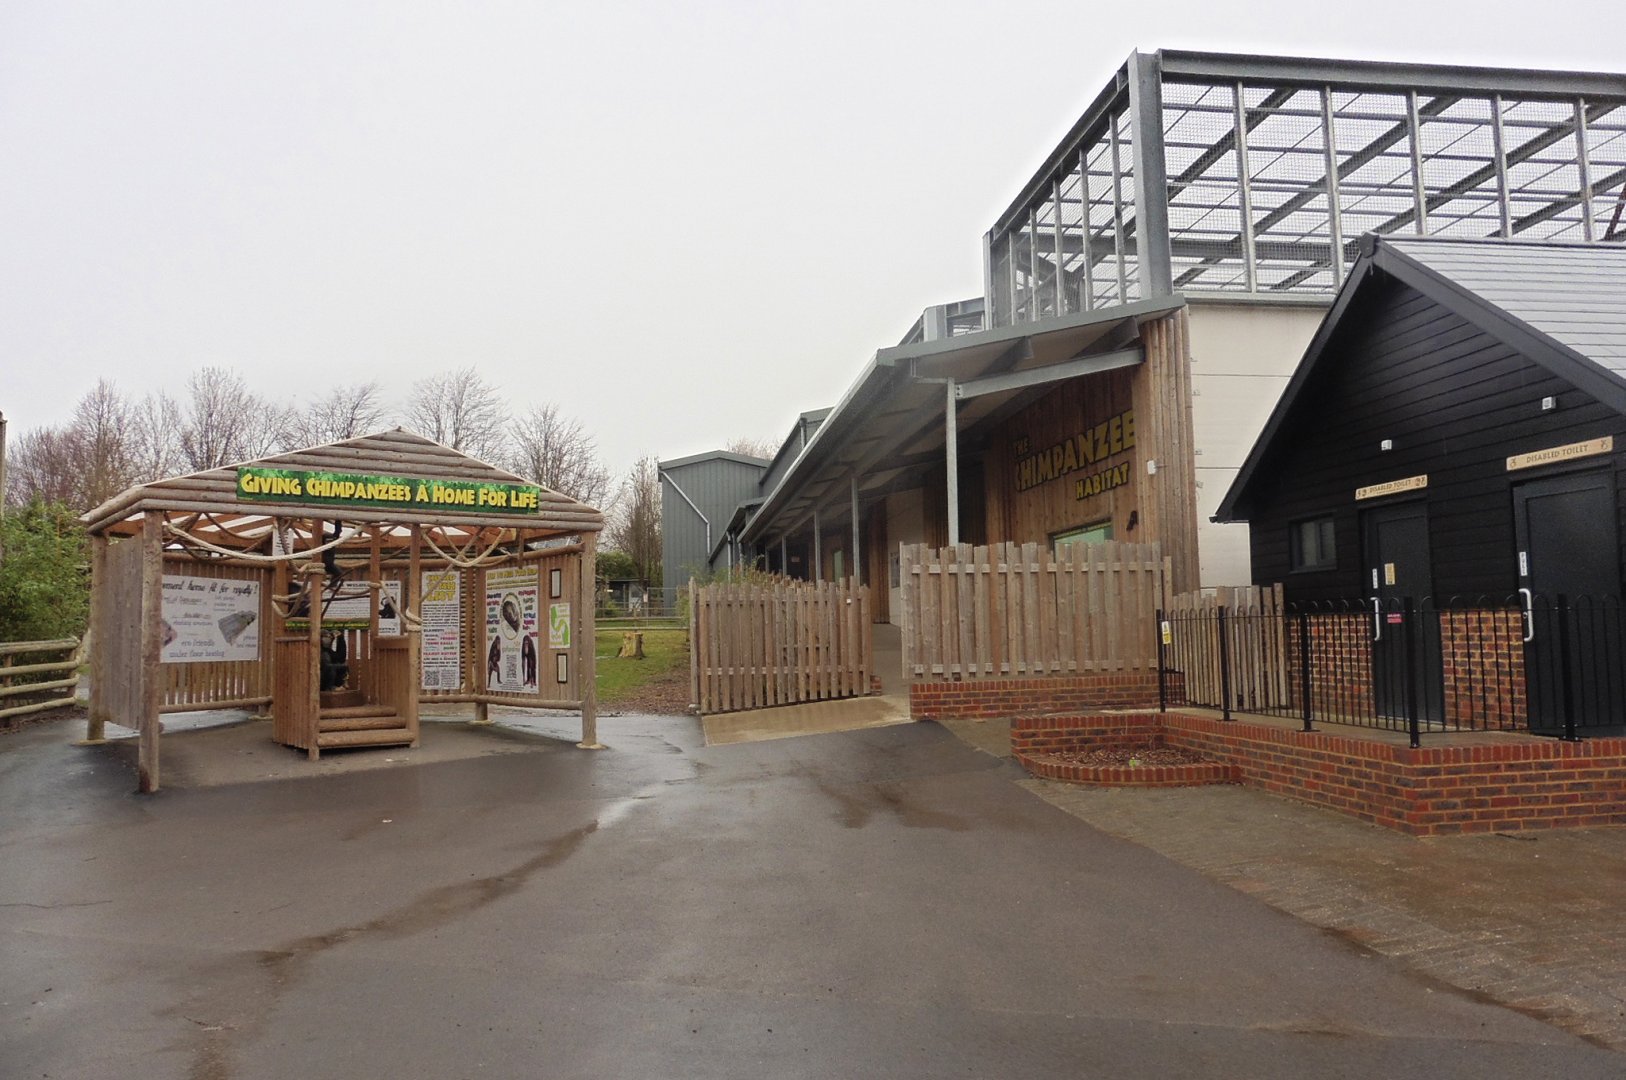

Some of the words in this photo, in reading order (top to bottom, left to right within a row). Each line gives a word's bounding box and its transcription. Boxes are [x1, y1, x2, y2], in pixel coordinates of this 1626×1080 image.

[1526, 450, 1560, 463] DISABLED
[1562, 444, 1589, 456] TOILET
[1076, 461, 1130, 500] HABITAT
[1369, 483, 1393, 493] DISABLED
[1394, 479, 1411, 488] TOILET
[240, 473, 302, 495] GIVING
[306, 477, 412, 502] CHIMPANZEES
[415, 485, 429, 502] A
[433, 485, 475, 506] HOME
[479, 488, 507, 507] FOR
[511, 489, 537, 509] LIFE
[219, 583, 230, 594] for
